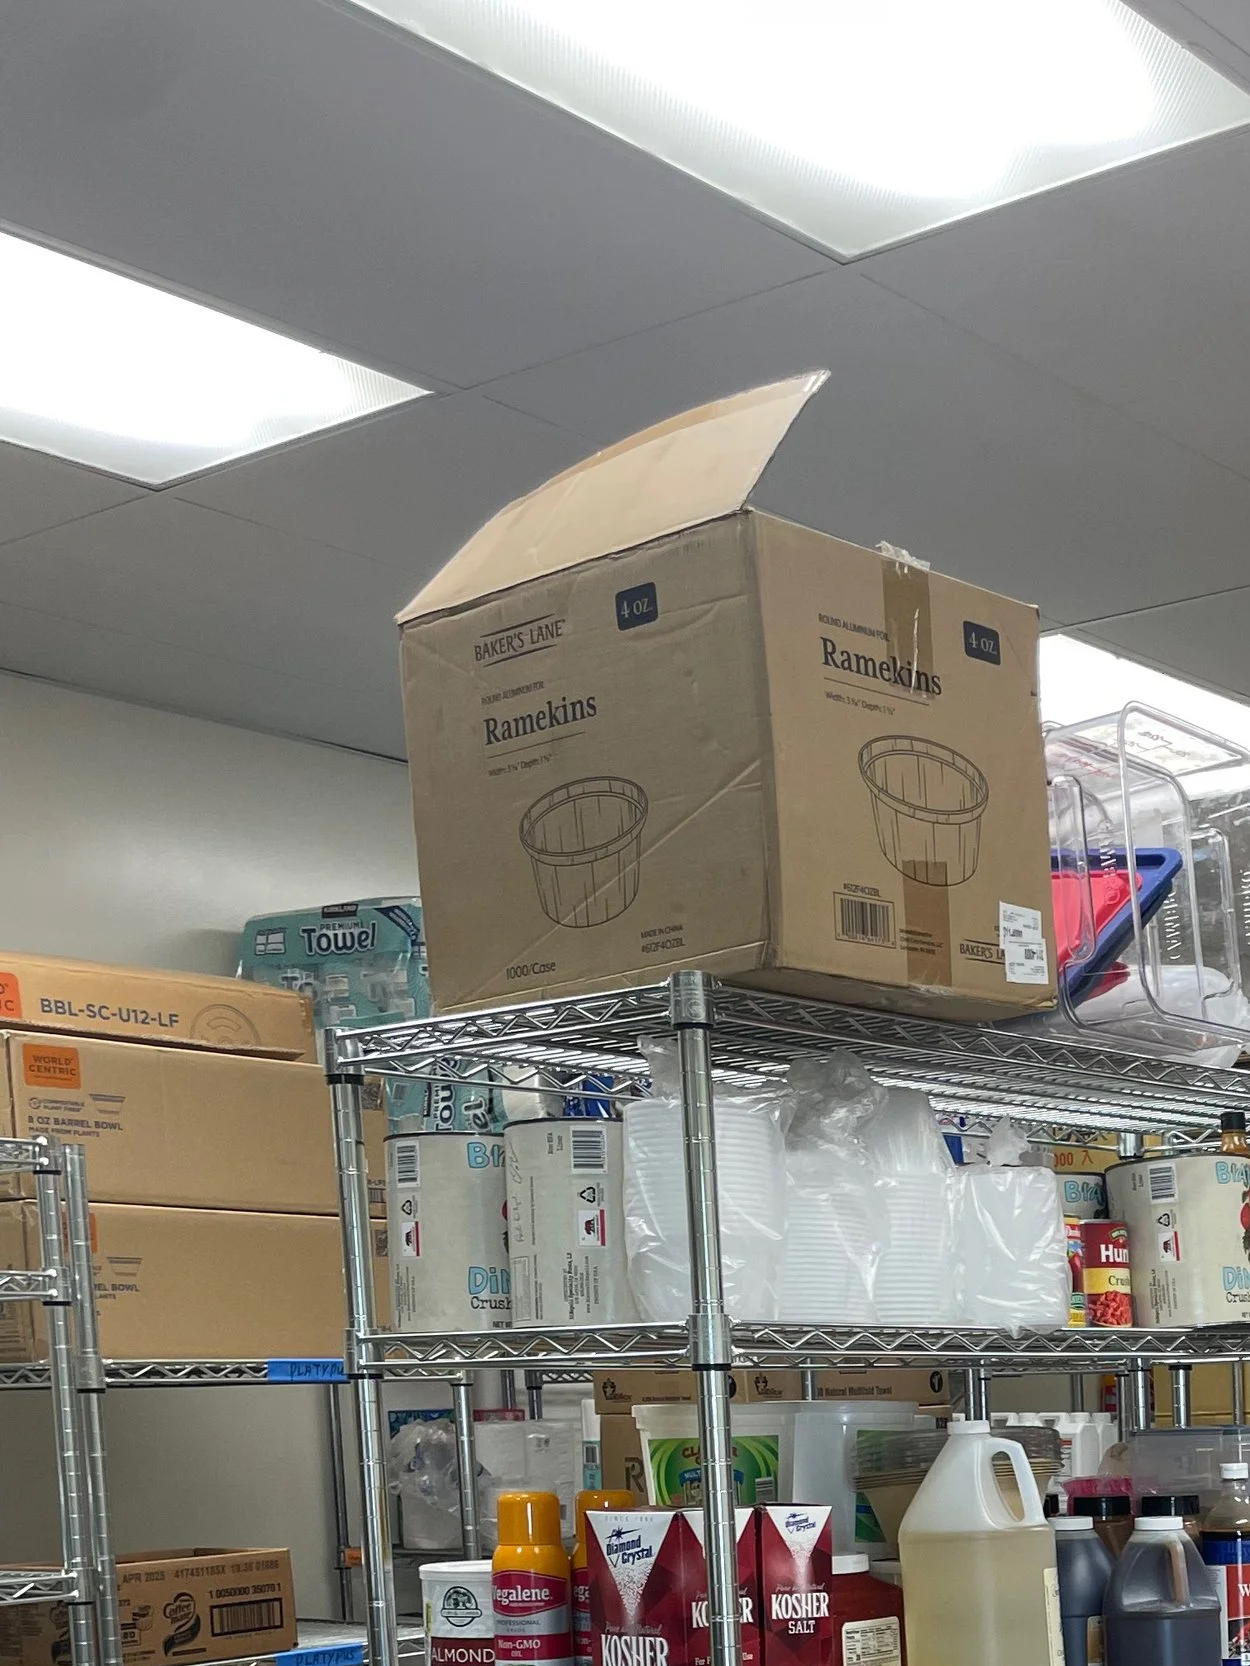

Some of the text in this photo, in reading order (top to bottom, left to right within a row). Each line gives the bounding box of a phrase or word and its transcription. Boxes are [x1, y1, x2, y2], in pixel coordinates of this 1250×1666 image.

[620, 601, 630, 618] 4
[474, 632, 525, 661] BAKER'S
[969, 632, 977, 648] 4
[820, 636, 942, 695] Ramekins
[483, 696, 597, 745] Ramekins
[301, 922, 377, 954] Towel
[959, 943, 993, 960] BAKER'S
[506, 962, 556, 979] 1000/Case
[40, 998, 180, 1027] BBL-SC-U12-LF
[32, 1055, 71, 1066] WORLD
[29, 1065, 76, 1076] CENTRIC
[37, 1116, 50, 1124] OZ
[53, 1118, 92, 1129] BARREL
[94, 1121, 123, 1131] BOWL
[1100, 1244, 1129, 1263] Hun
[289, 1363, 344, 1381] PLATYPU
[606, 1535, 642, 1556] Diamond
[621, 1545, 653, 1565] Crystal
[771, 1592, 829, 1620] KOSHER
[788, 1620, 816, 1634] SALT
[432, 1649, 495, 1663] ALMOND
